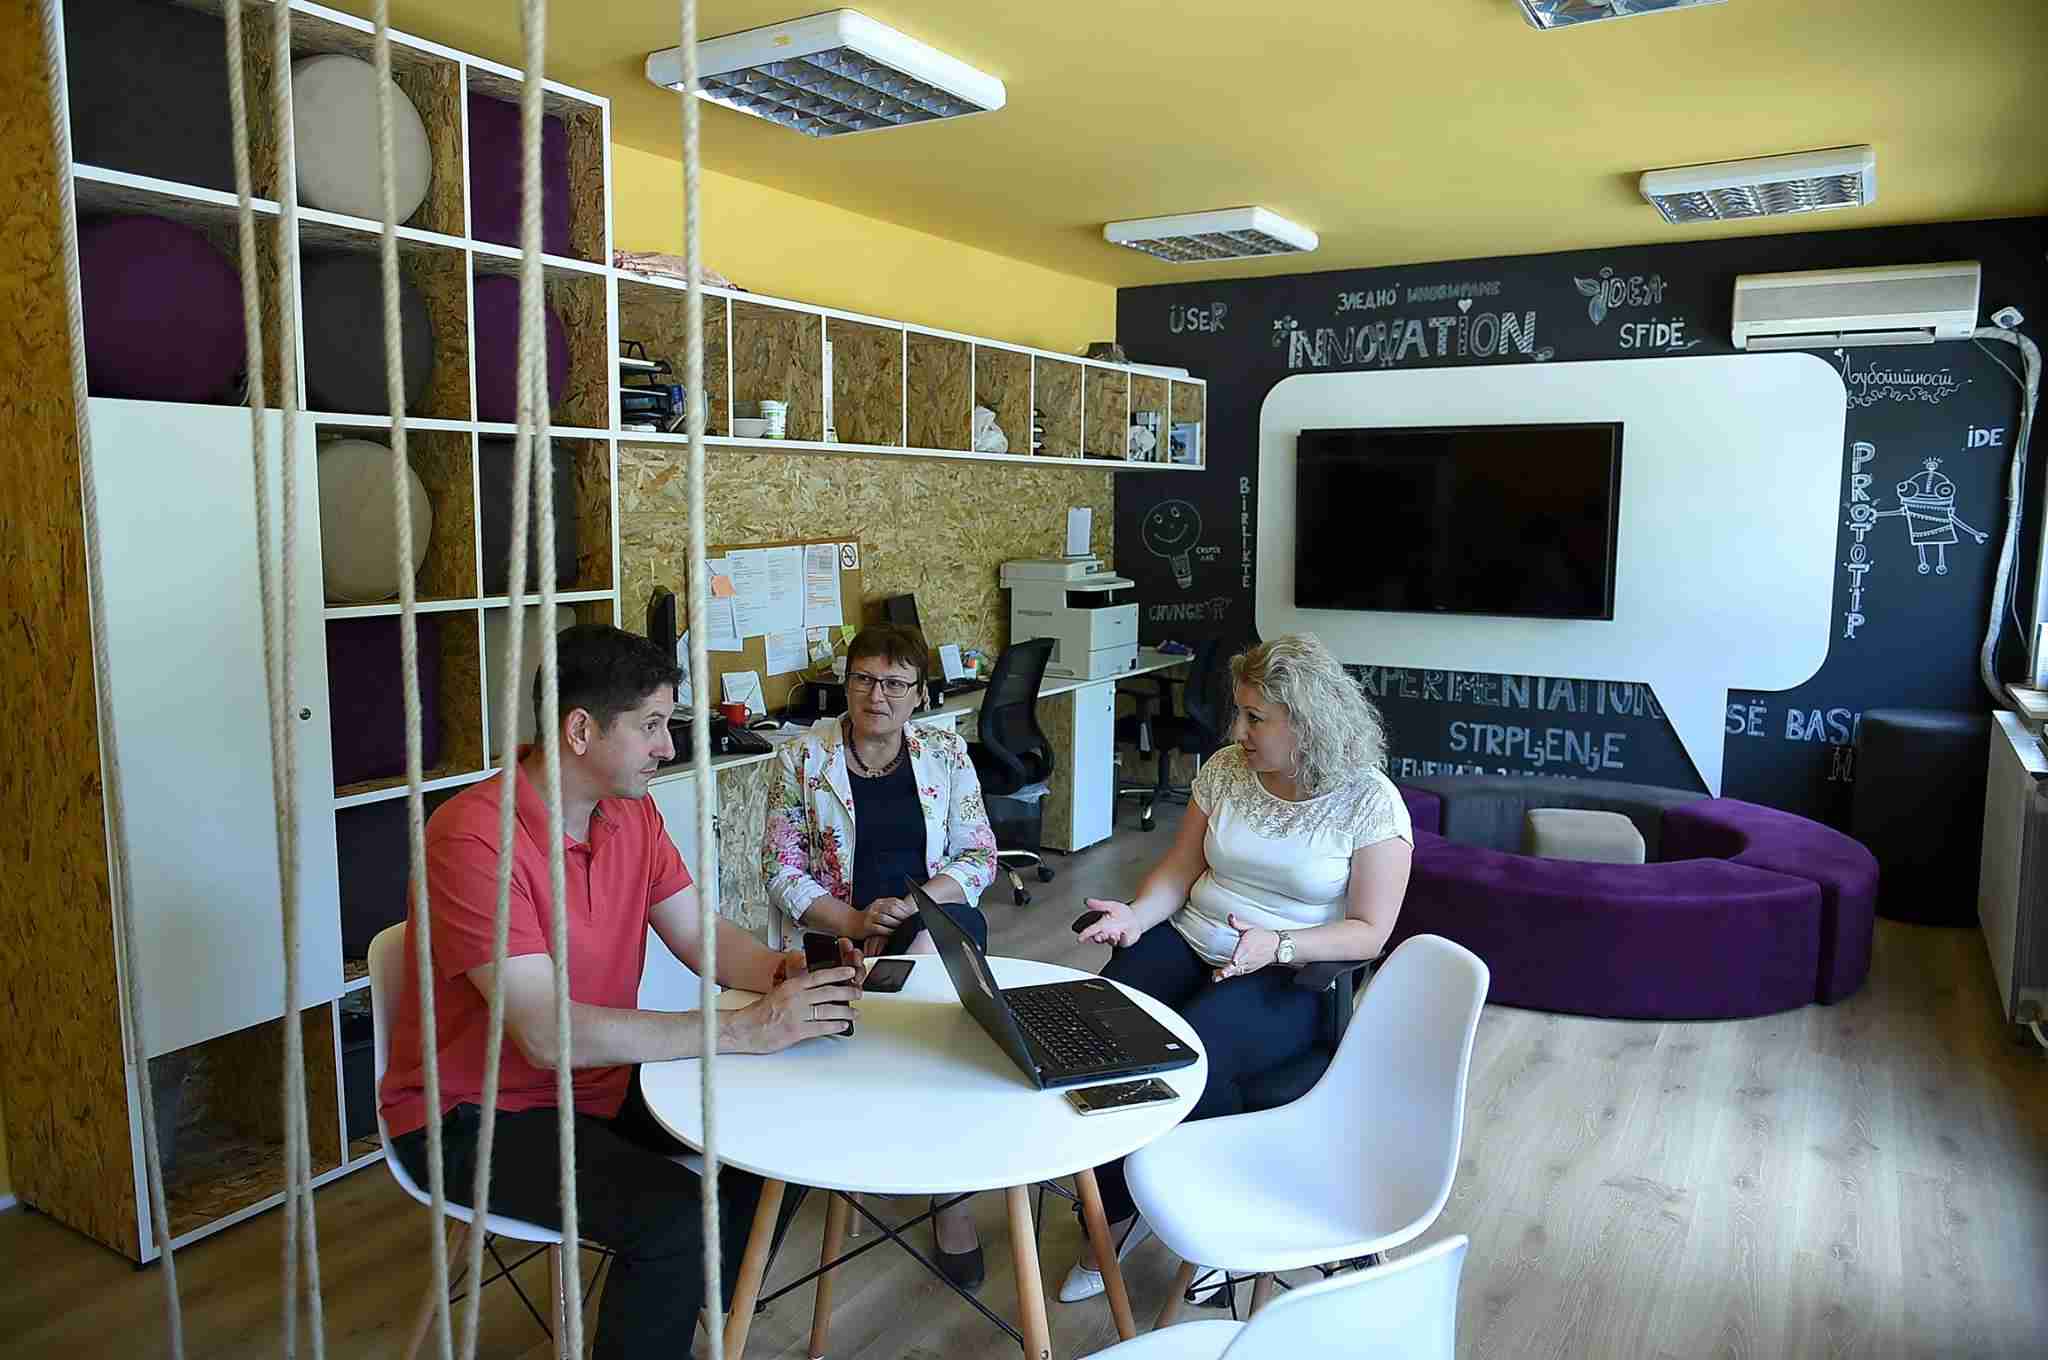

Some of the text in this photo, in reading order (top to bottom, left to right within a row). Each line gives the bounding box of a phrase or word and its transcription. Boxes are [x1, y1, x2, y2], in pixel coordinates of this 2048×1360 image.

[1239, 476, 1252, 588] BIRLIKTE
[1847, 441, 1876, 640] PROTOTIP
[1725, 699, 1767, 736] SË
